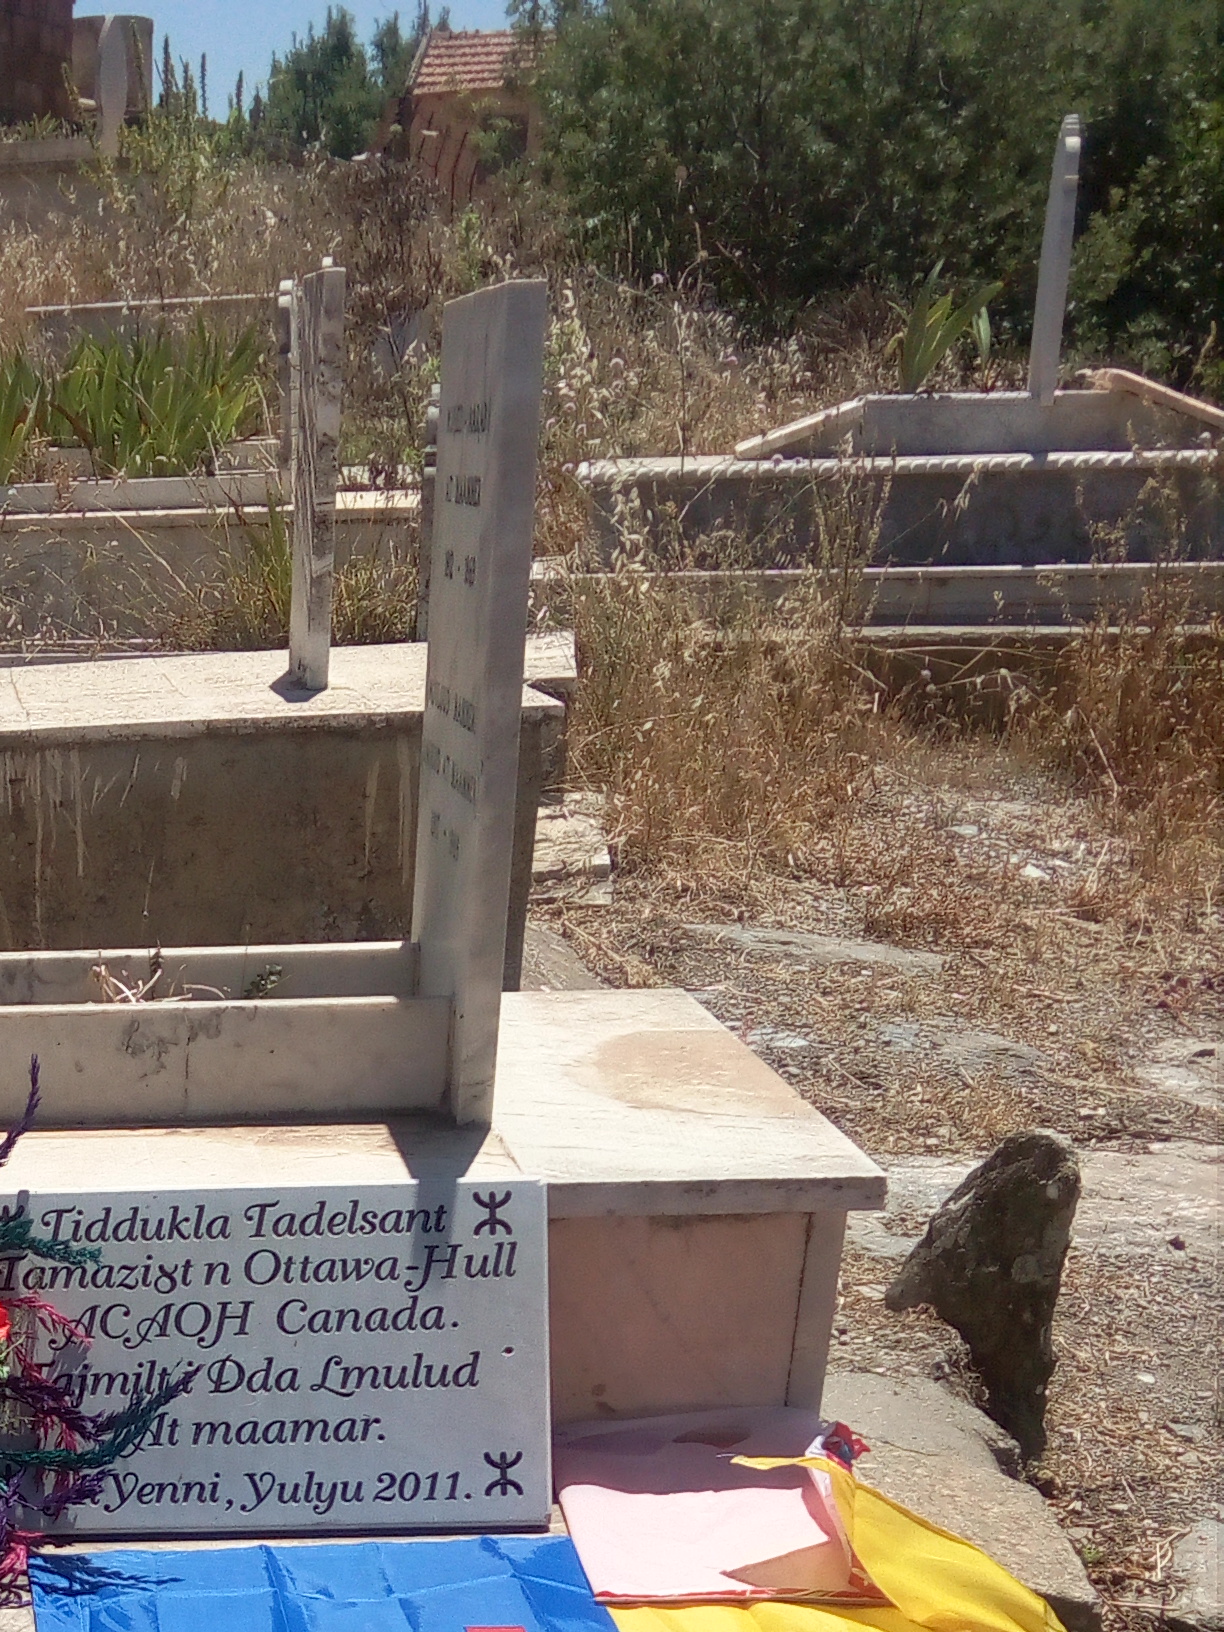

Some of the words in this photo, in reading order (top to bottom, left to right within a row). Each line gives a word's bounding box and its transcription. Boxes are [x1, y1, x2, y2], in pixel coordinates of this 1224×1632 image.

[40, 1203, 232, 1244] Tiddukla
[243, 1199, 448, 1239] Tadelsant
[203, 1260, 232, 1287] n
[243, 1241, 518, 1292] Ottawa-Hull
[276, 1296, 460, 1336] Canada.
[206, 1353, 300, 1395] Dda
[309, 1350, 481, 1398] Lmulud
[191, 1416, 387, 1446] maamar.
[239, 1470, 365, 1516] Yulyu
[372, 1470, 473, 1502] 2011.
